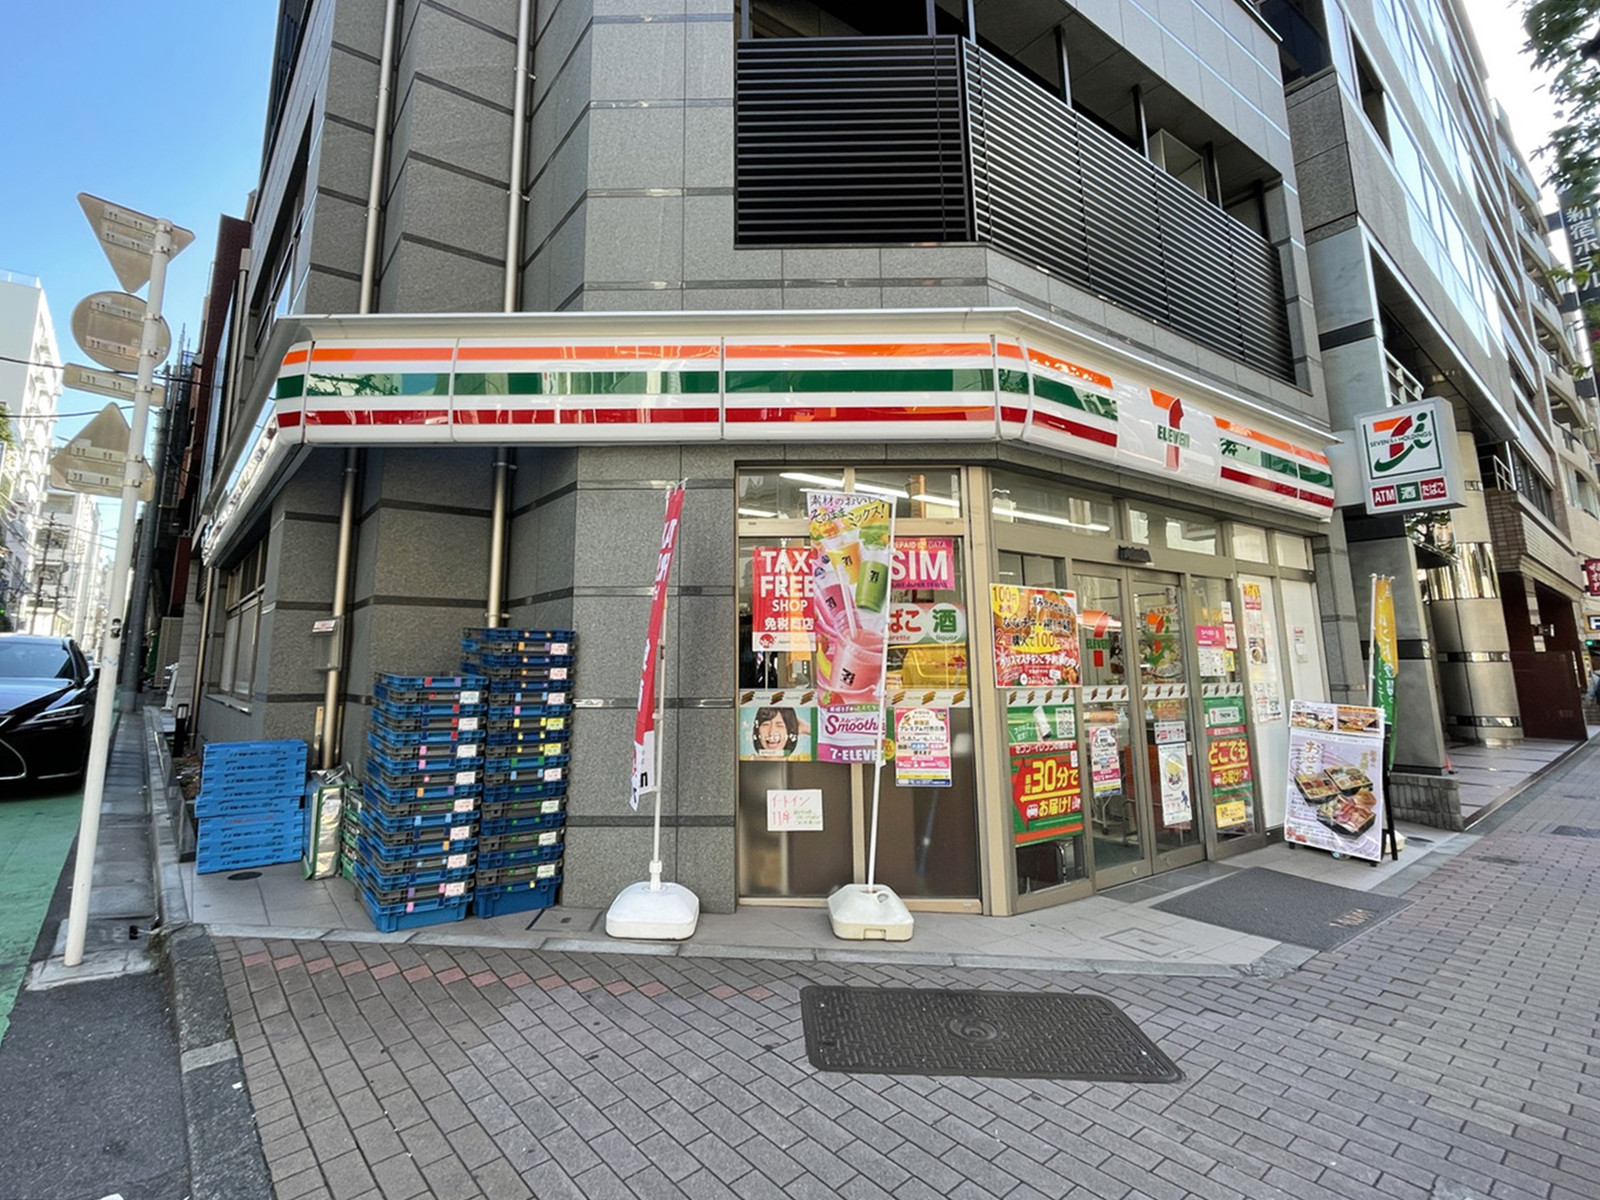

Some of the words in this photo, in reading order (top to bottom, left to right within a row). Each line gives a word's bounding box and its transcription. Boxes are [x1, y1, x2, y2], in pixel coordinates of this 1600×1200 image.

[1374, 489, 1396, 504] ATM
[1401, 485, 1417, 500] 酒
[1421, 482, 1446, 497] たばこ
[891, 550, 948, 581] SIM
[760, 575, 815, 598] FREE
[771, 599, 809, 613] SHOP
[889, 608, 922, 633] ばこ
[932, 609, 957, 633] 酒
[1208, 739, 1249, 765] どこでも
[1031, 758, 1079, 794] 30分で
[1039, 795, 1072, 817] お届け!
